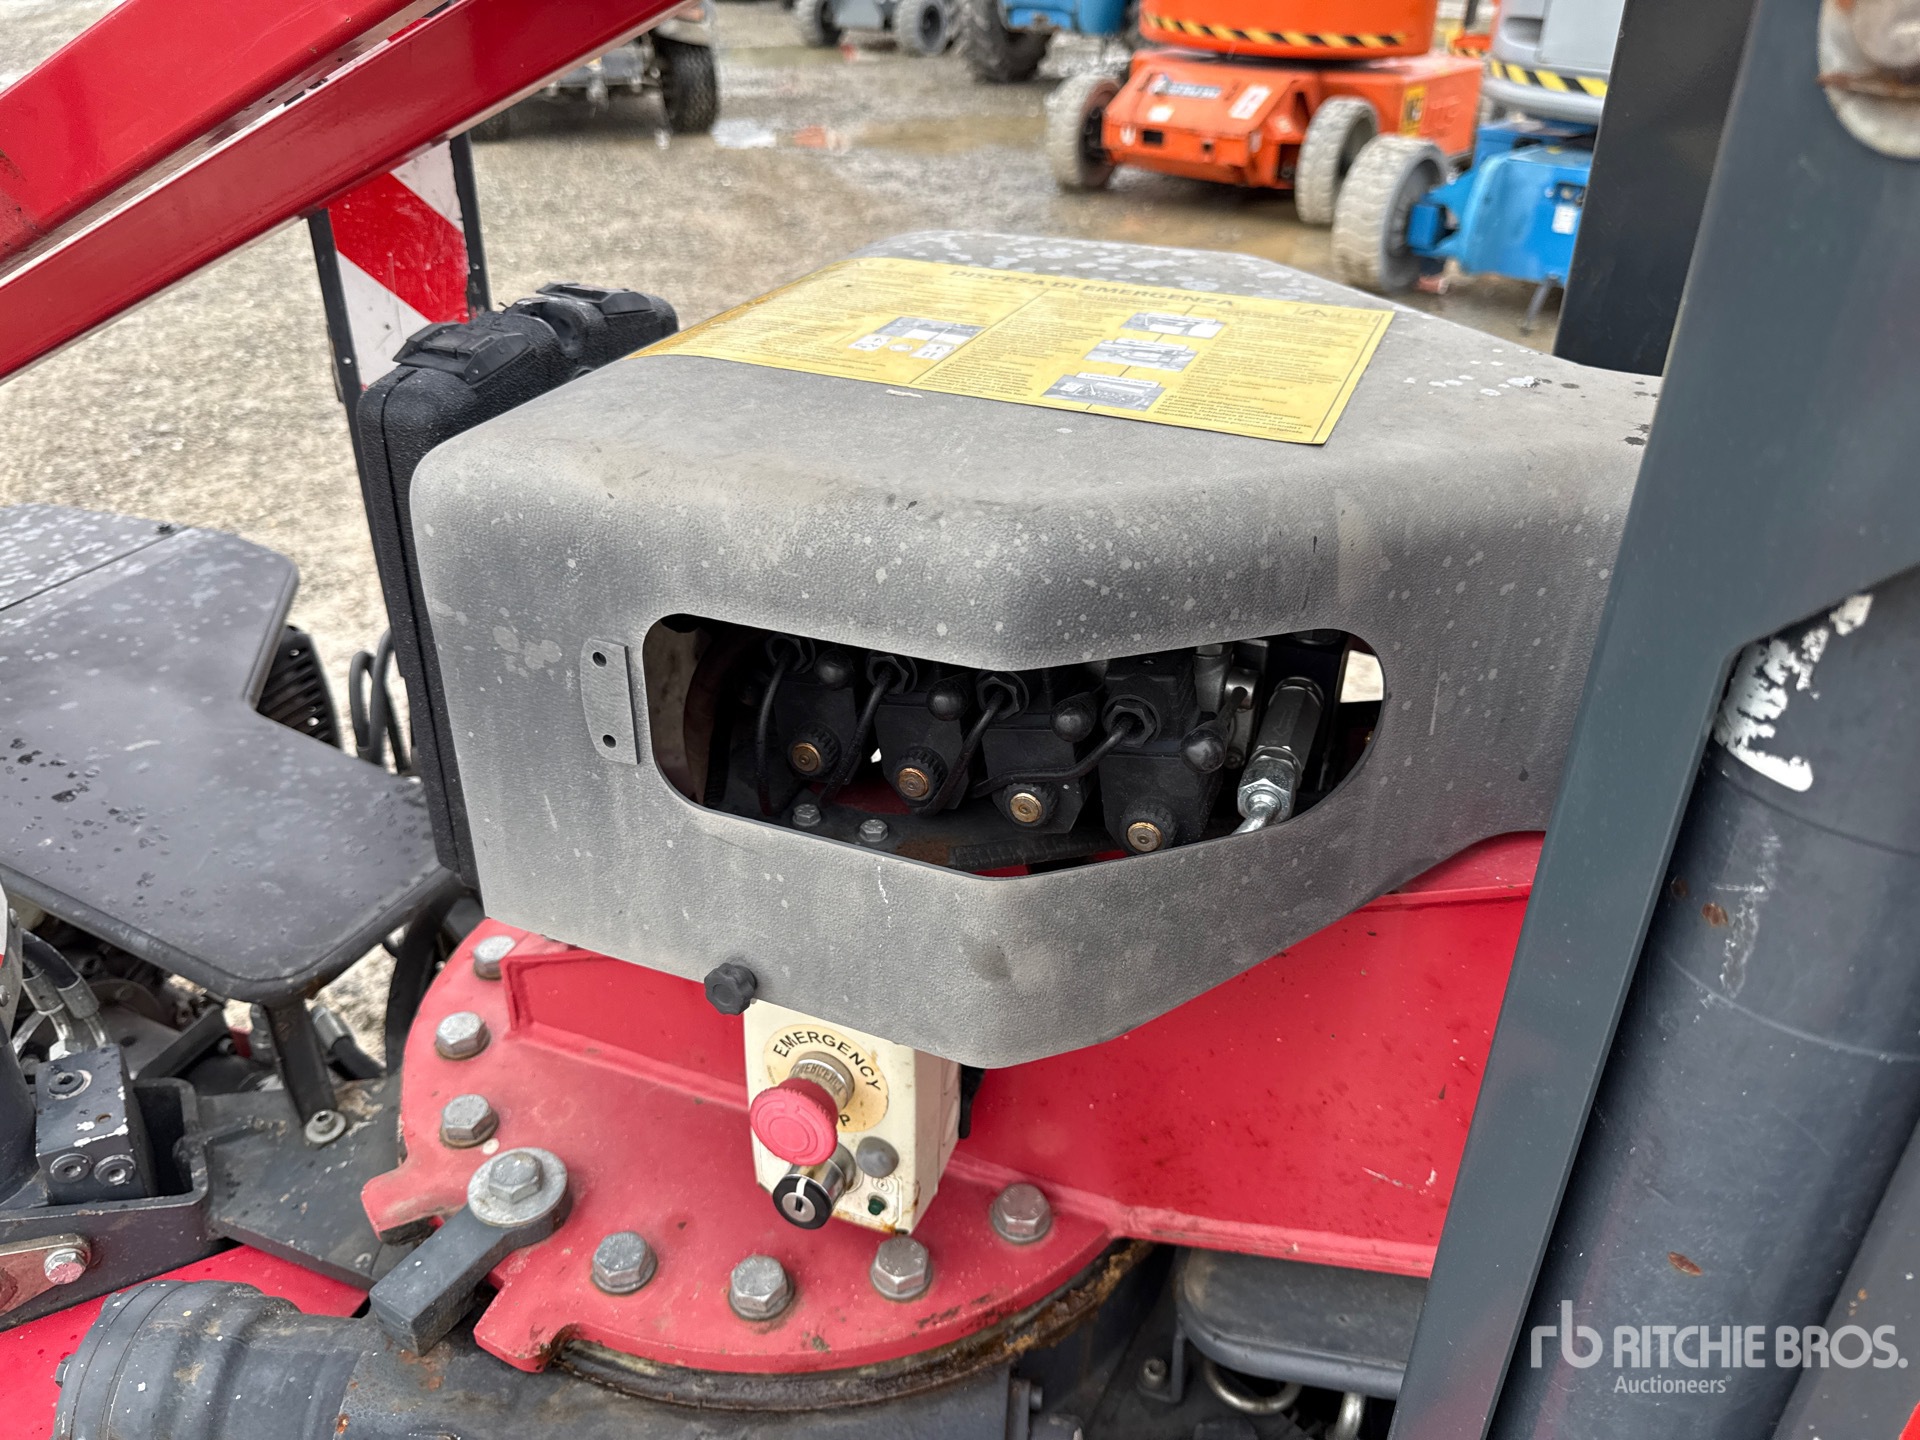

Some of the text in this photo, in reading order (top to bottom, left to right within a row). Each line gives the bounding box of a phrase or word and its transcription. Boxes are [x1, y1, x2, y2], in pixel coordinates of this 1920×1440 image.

[949, 270, 1234, 306] DISCESA DI EMERGENZA
[773, 1031, 881, 1091] EMERGENCY
